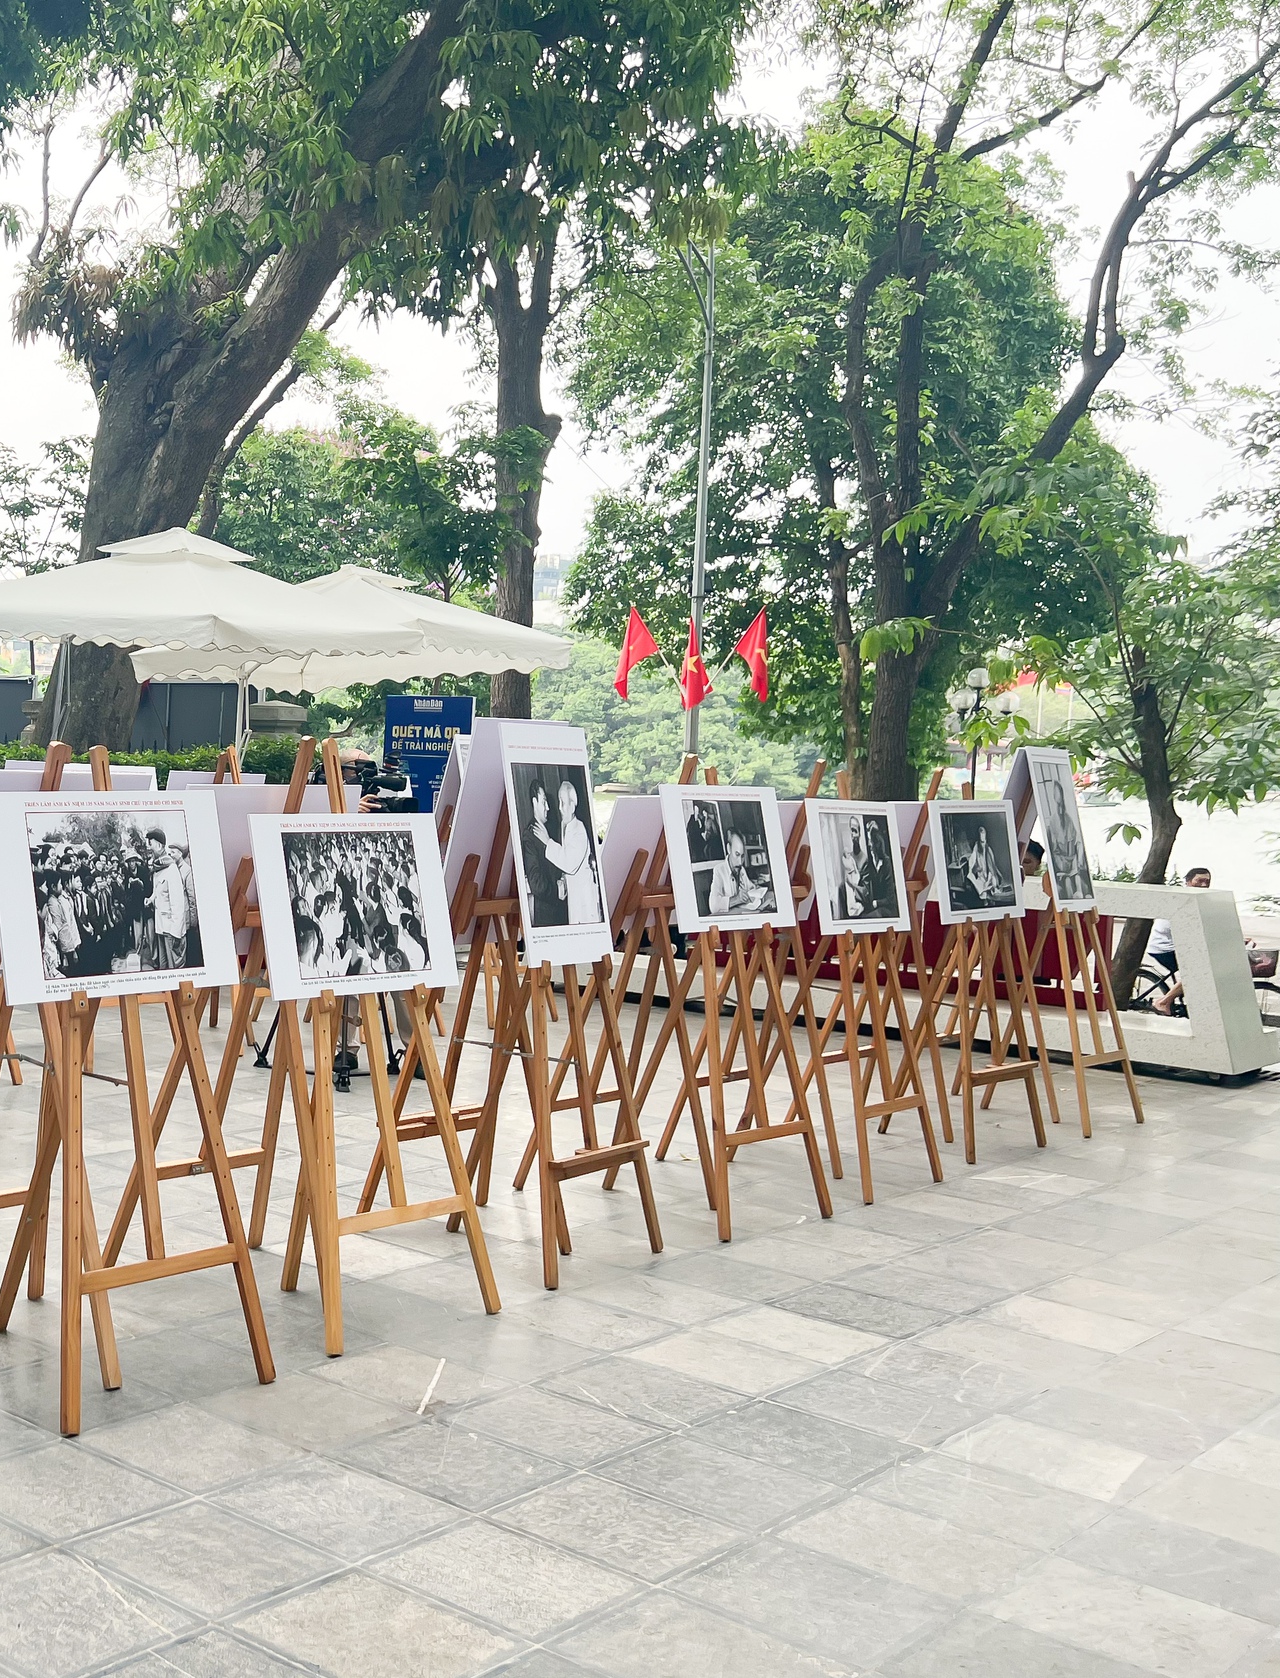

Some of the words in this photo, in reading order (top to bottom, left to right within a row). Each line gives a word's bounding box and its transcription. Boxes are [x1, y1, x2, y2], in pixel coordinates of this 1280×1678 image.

[392, 725, 422, 738] QUÉT
[424, 724, 442, 738] MÃ
[392, 738, 403, 749] ĐỂ
[405, 741, 424, 750] TRẢI
[426, 742, 452, 752] NGHIỆ
